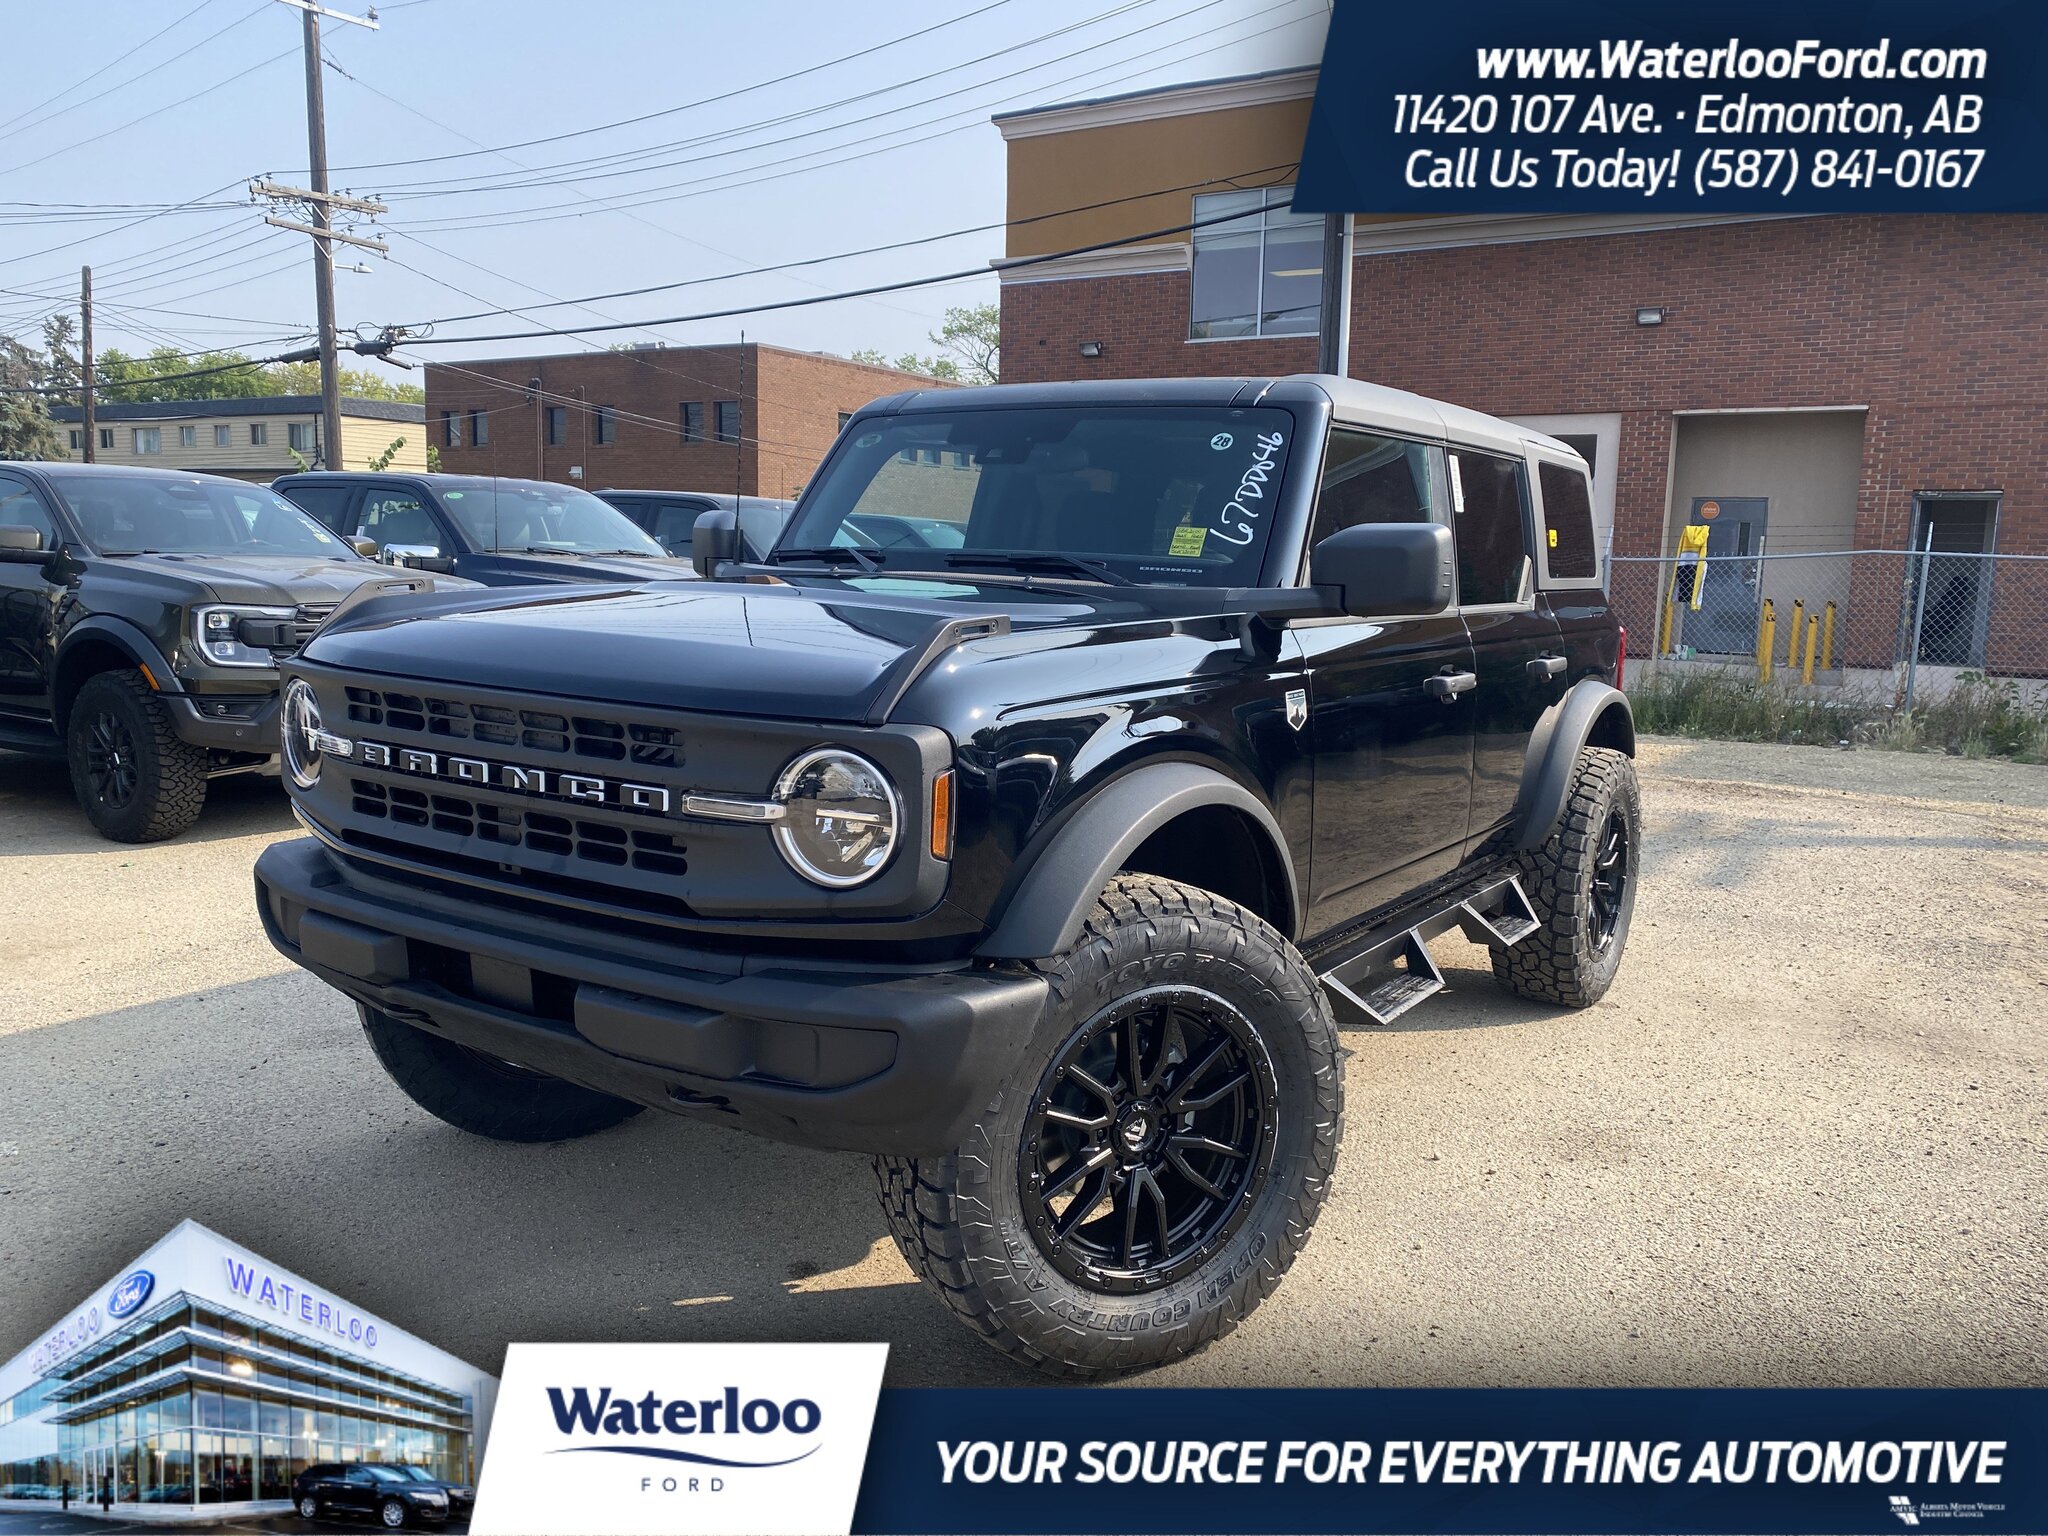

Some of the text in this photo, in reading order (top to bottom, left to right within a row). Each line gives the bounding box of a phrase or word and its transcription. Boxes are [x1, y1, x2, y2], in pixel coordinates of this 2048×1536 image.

[1212, 435, 1232, 449] 28
[354, 739, 670, 813] BRONCO
[1197, 1231, 1268, 1309] OPEN
[1049, 1297, 1192, 1333] COUNTRY
